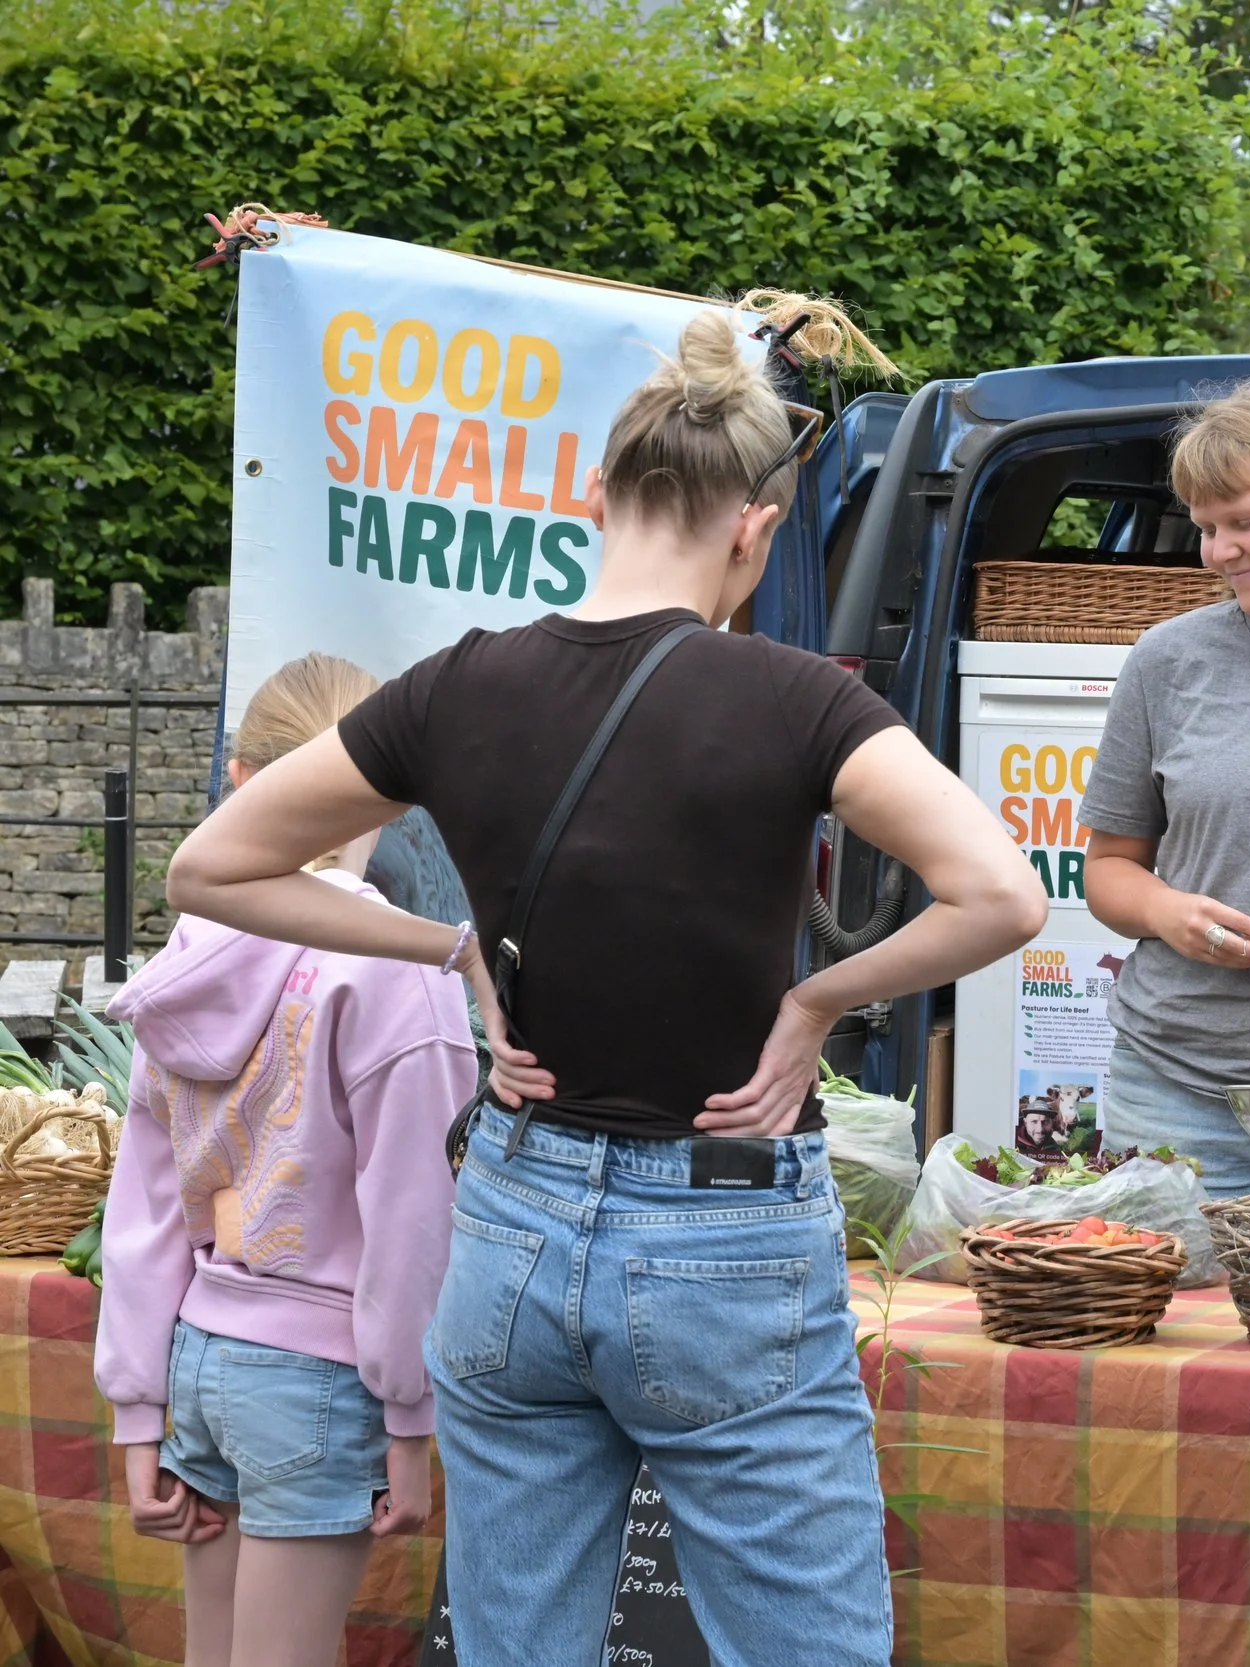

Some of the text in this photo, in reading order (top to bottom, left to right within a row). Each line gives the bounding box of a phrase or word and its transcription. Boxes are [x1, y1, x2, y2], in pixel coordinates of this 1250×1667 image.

[323, 311, 561, 419] GOOD
[324, 399, 591, 518] SMALL
[327, 486, 590, 606] FARMS
[1081, 684, 1108, 692] BOSCH
[1000, 743, 1099, 795] GOO
[1022, 949, 1065, 965] GOOD
[1022, 965, 1073, 982] SMALL
[1022, 981, 1073, 998] FARMS
